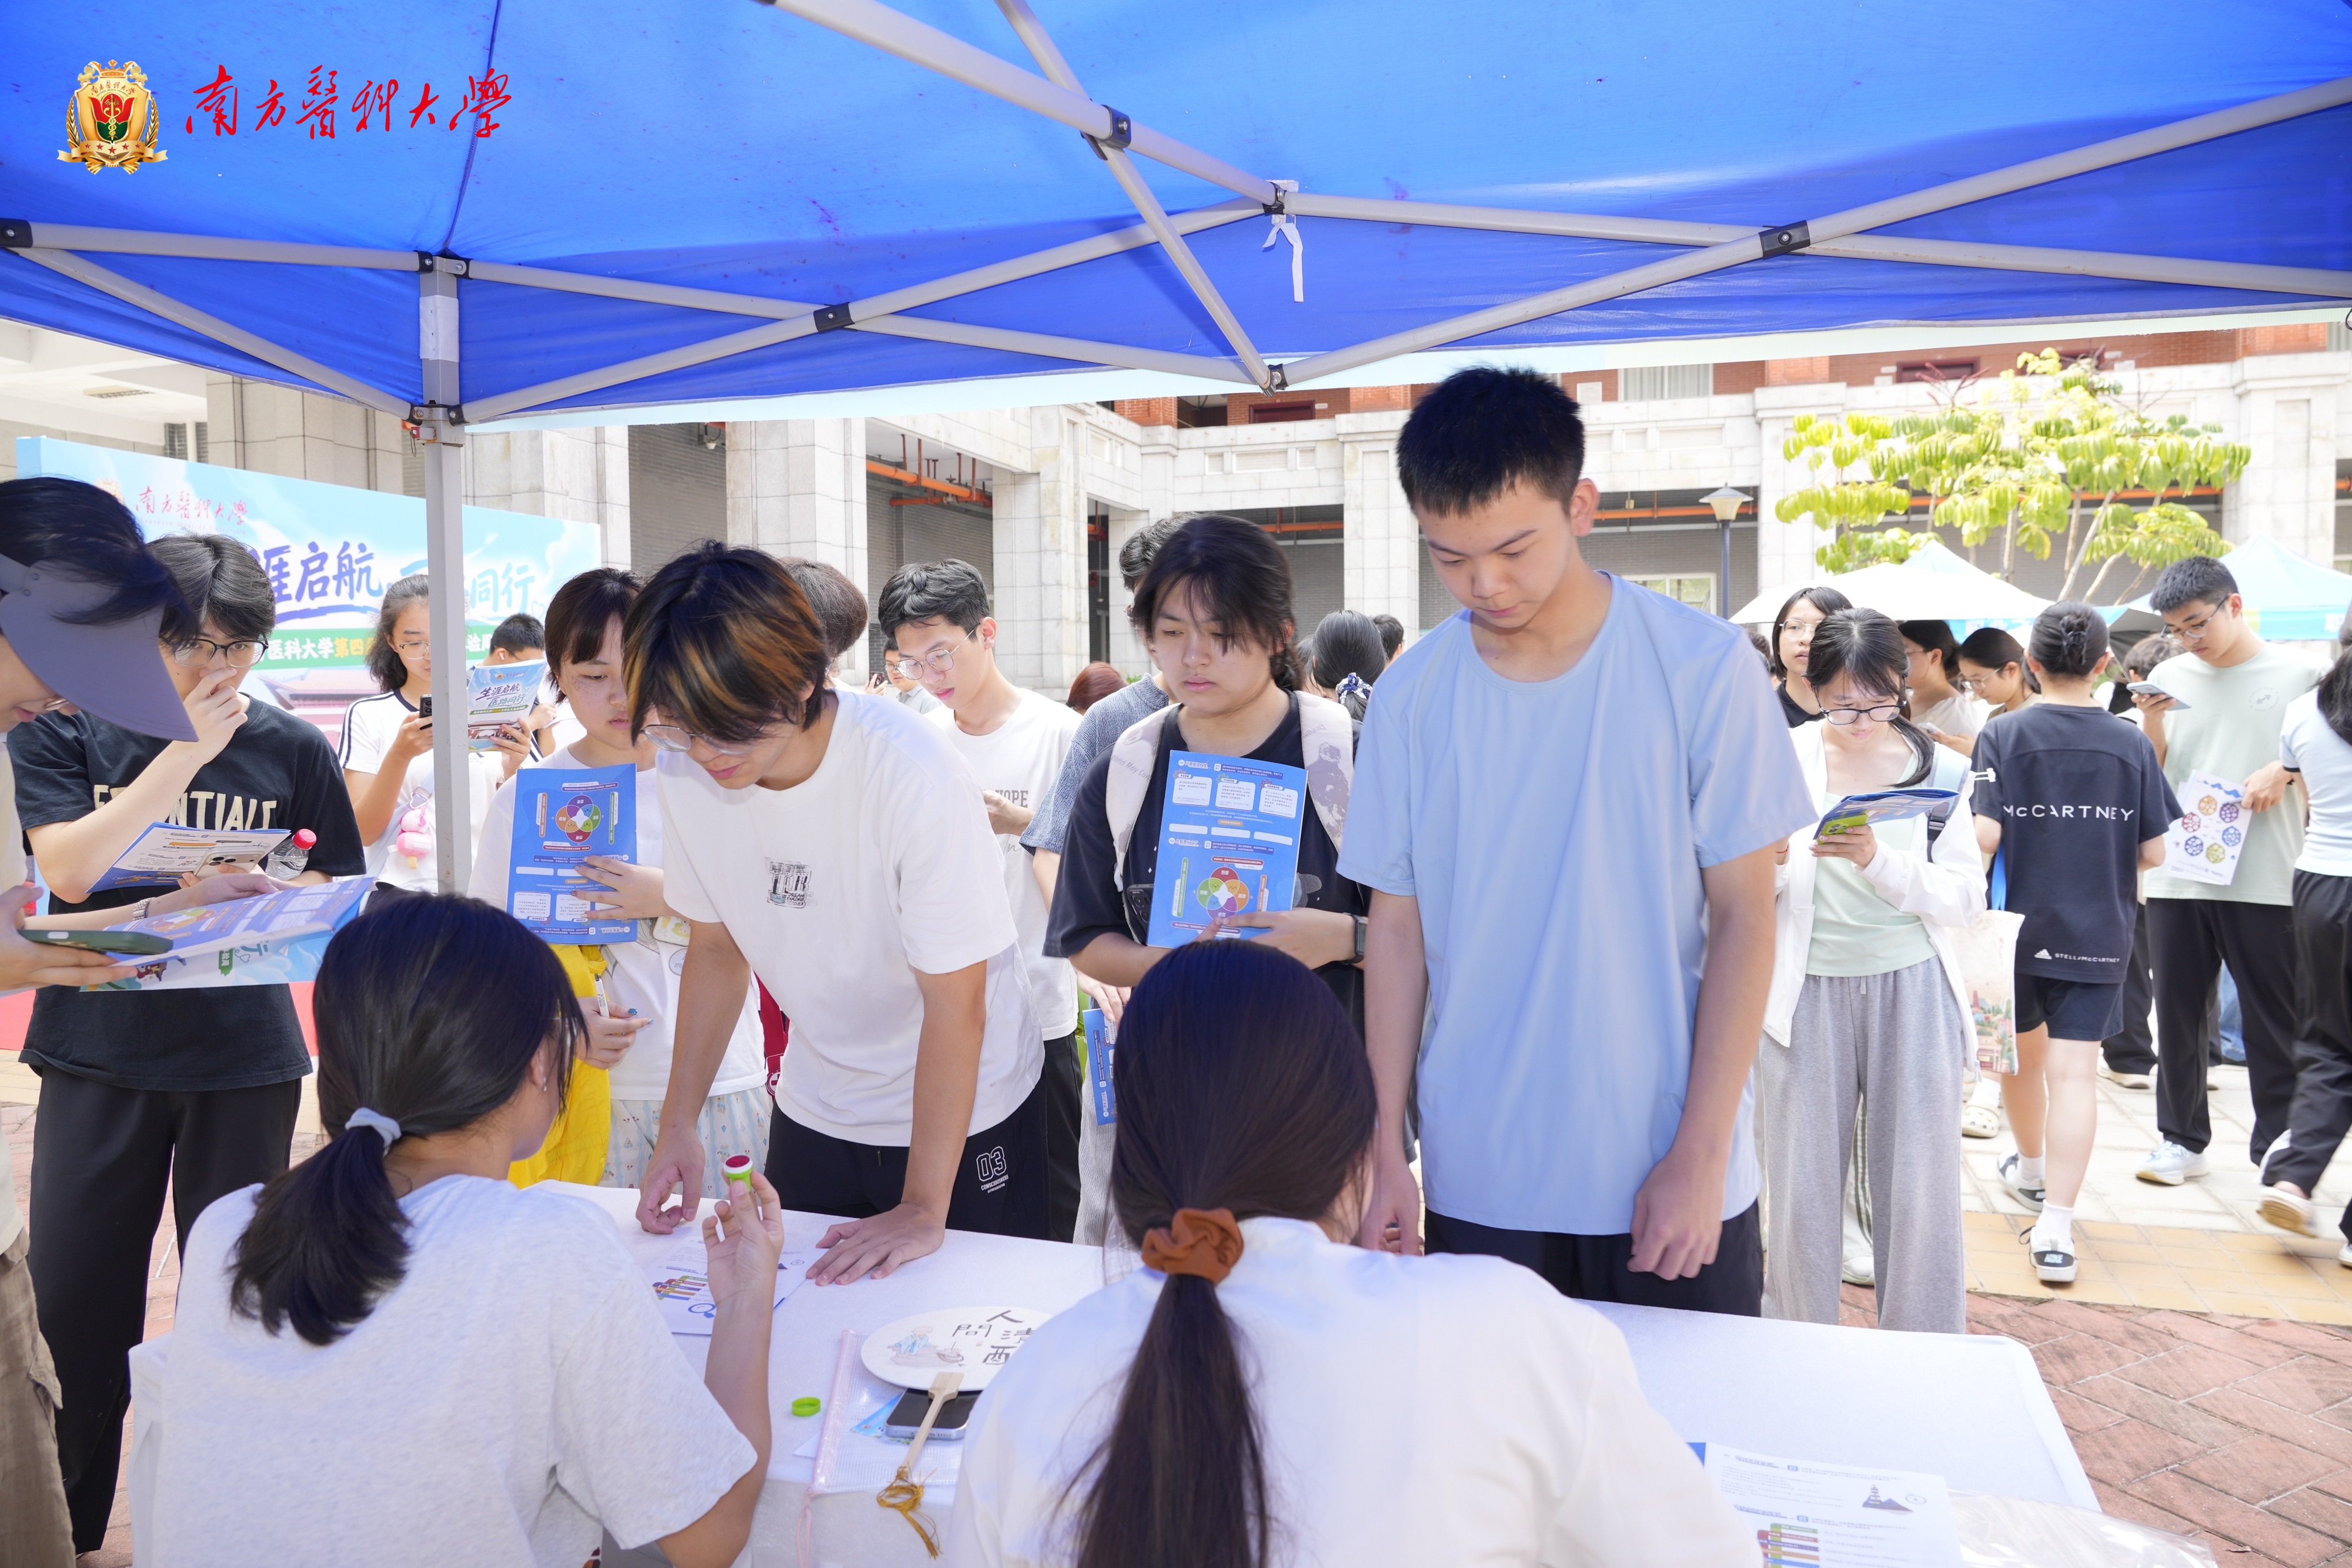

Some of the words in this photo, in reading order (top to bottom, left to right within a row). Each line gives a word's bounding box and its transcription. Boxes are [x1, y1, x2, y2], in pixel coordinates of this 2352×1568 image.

[476, 683, 520, 701] 生涯启航
[976, 1146, 1007, 1182] 03
[981, 1174, 1009, 1191] CONSCIOUSNESS
[2044, 1253, 2064, 1264] NIKE
